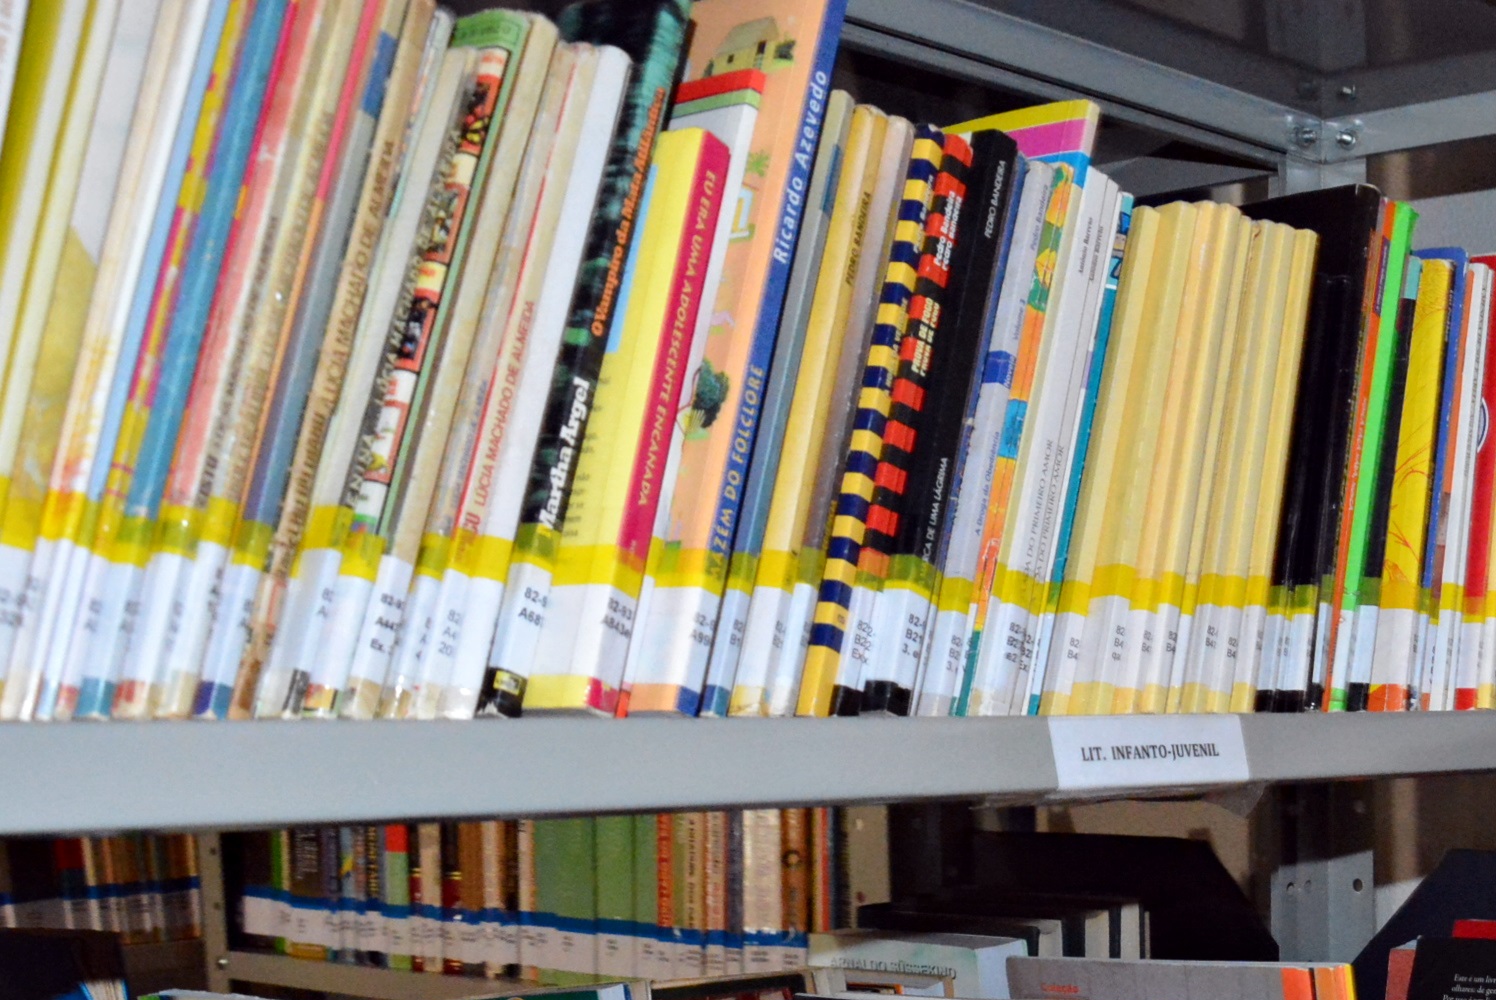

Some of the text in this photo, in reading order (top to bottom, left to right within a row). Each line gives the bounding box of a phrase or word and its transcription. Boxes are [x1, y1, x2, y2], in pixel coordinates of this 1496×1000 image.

[635, 87, 667, 173] Atlântica
[774, 71, 828, 265] Ricardo Azevedo
[616, 226, 629, 245] da
[622, 174, 641, 222] Mata
[933, 190, 957, 266] Pedro Bandeira
[984, 160, 1007, 240] PEDRO BANDEIRA
[595, 246, 620, 320] Vampiro
[638, 170, 717, 506] EU ERA UMA ADOLESCENTE ENCANADA
[911, 297, 934, 373] PROVA DE FOGO
[536, 375, 591, 530] Martha Argel
[1081, 743, 1220, 762] LIT. INFANTO-JUVENIL
[1454, 974, 1467, 983] Este
